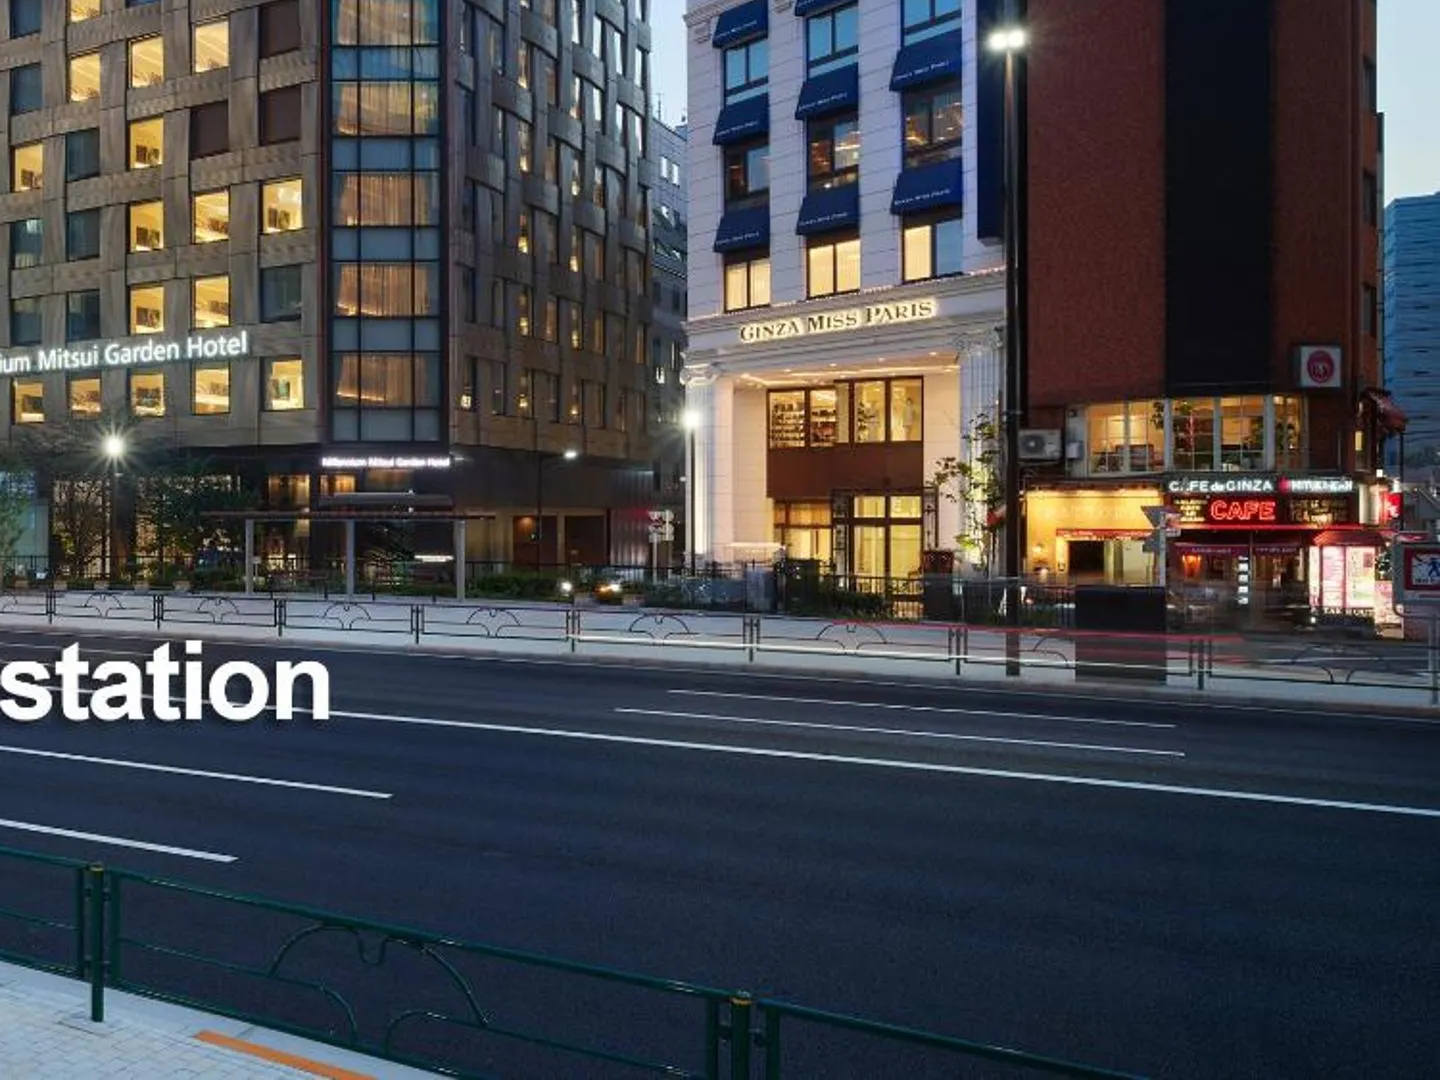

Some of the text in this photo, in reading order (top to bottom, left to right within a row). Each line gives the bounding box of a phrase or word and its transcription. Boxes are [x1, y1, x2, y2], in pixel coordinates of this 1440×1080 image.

[740, 301, 933, 342] GINZA MISS PARIS
[37, 346, 98, 370] Mitsui
[104, 339, 179, 364] Garden
[186, 331, 248, 358] Hotel
[1226, 479, 1273, 491] GINZA
[1210, 500, 1276, 520] CAFE
